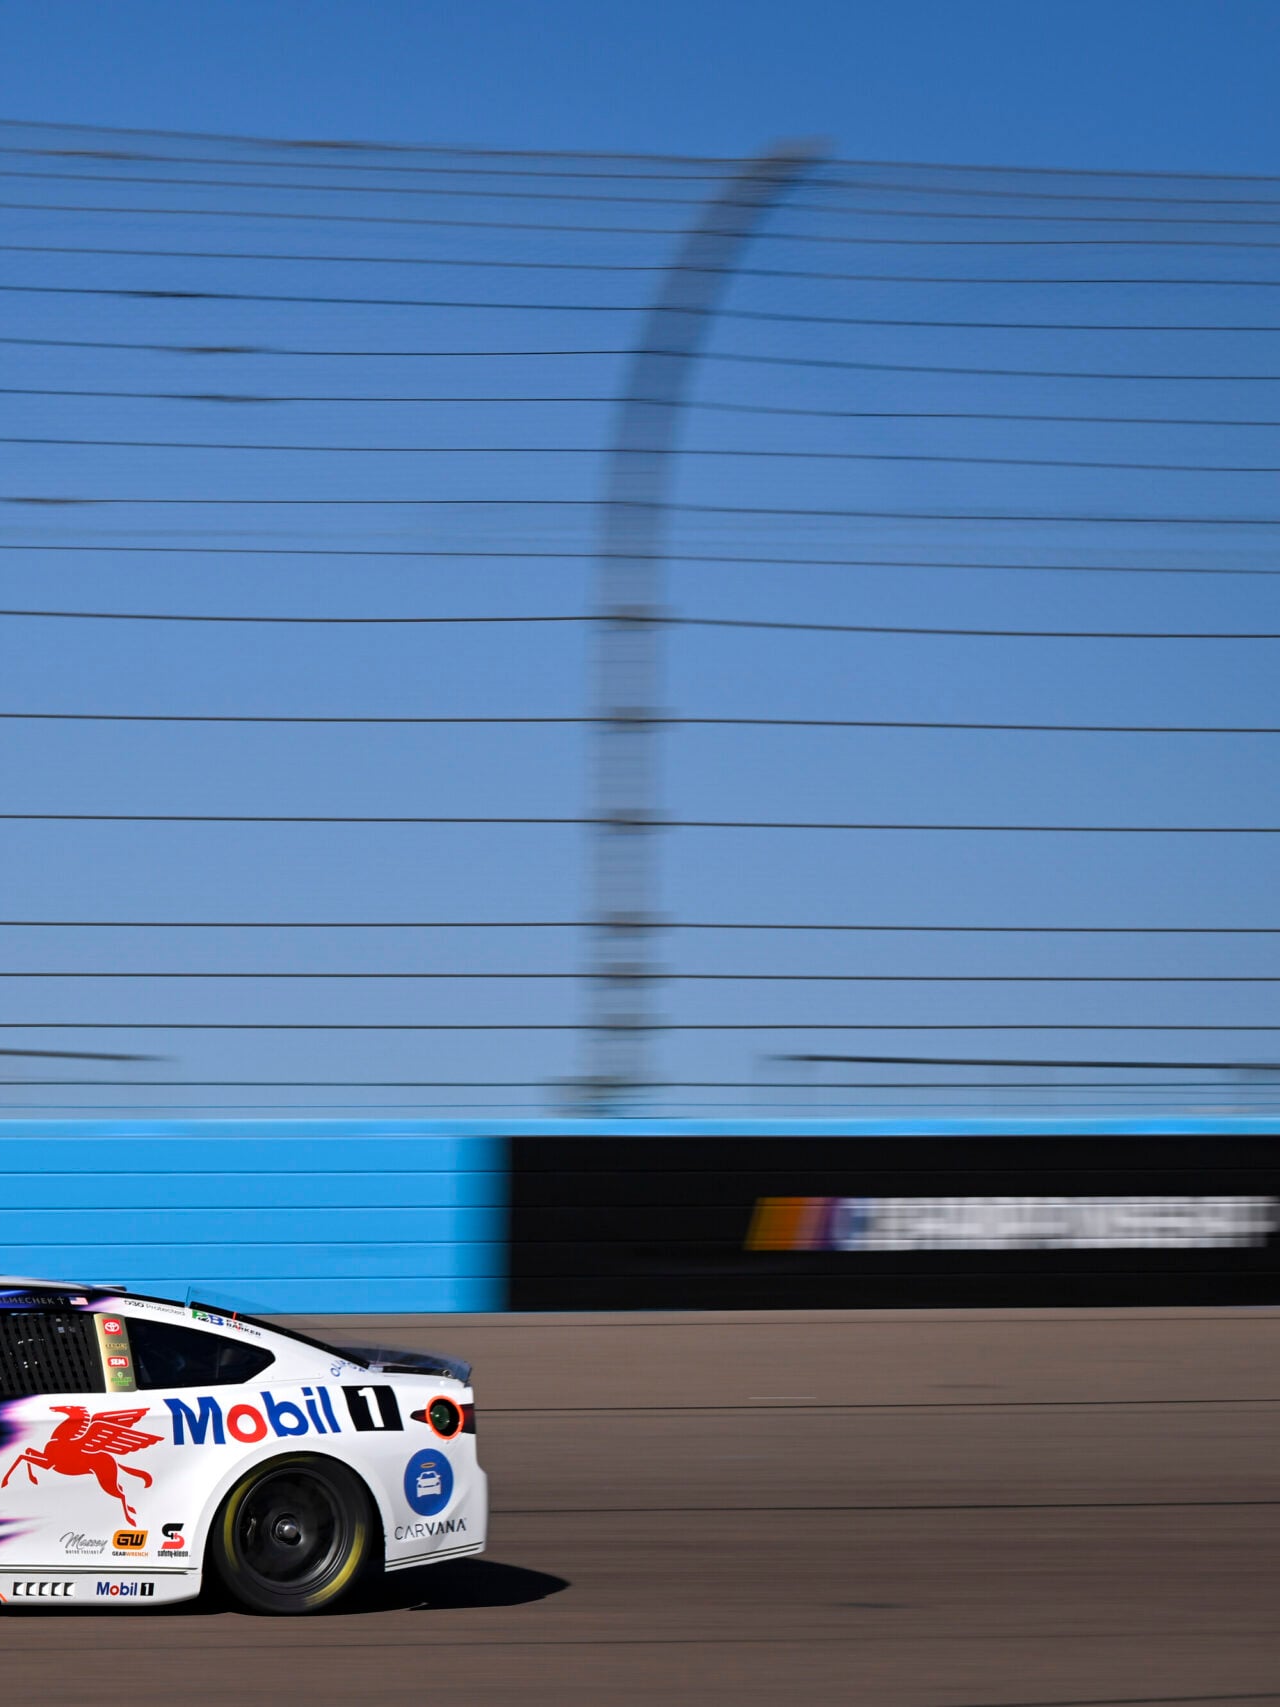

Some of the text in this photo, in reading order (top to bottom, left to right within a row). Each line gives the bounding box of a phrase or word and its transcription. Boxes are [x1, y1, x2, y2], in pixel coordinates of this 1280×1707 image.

[163, 1386, 341, 1445] Mobil
[394, 1518, 467, 1541] CARVANA
[116, 1533, 145, 1546] GW
[96, 1582, 138, 1596] Mobil
